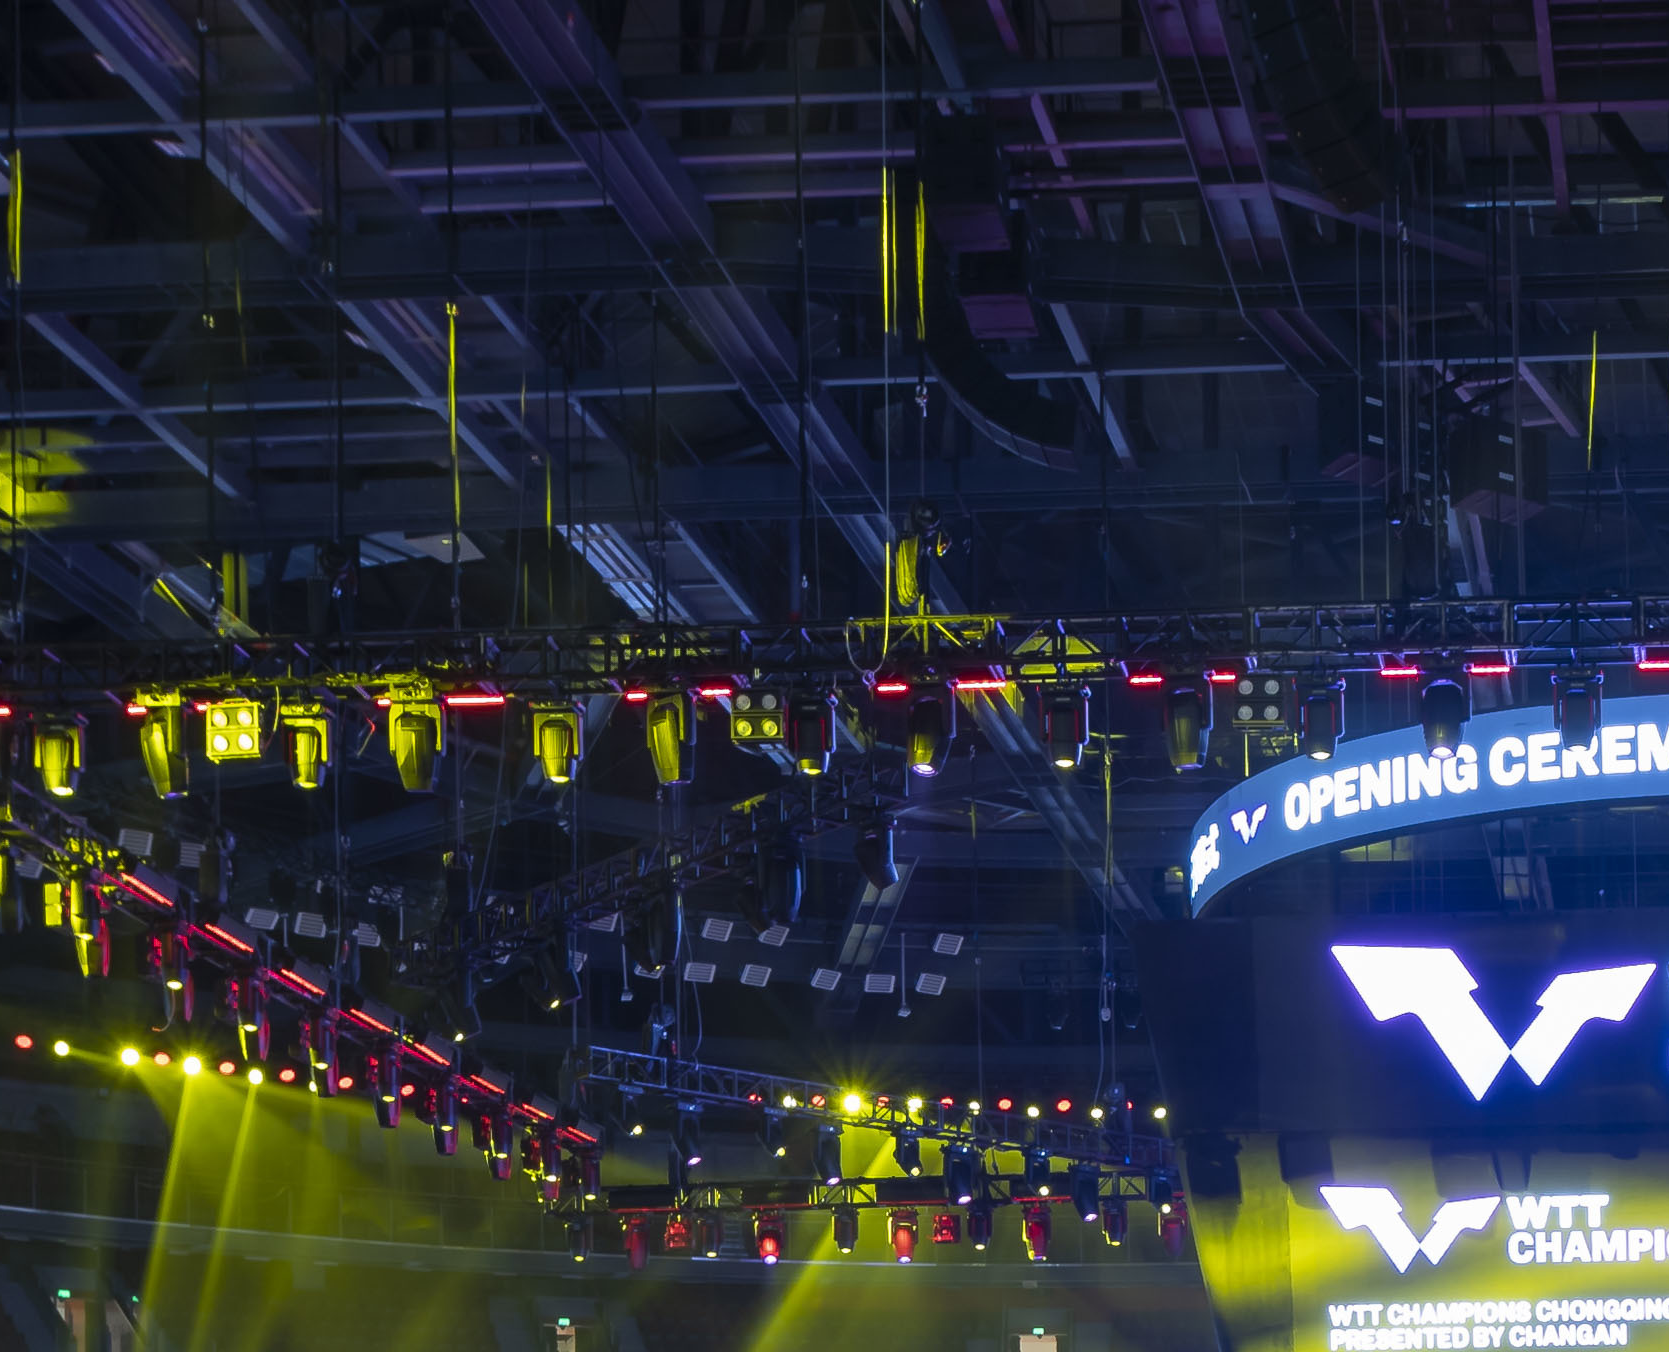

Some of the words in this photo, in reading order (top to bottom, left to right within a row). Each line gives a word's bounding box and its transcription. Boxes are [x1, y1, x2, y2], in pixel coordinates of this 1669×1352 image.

[1283, 743, 1479, 831] OPENING
[1505, 1194, 1610, 1230] WTT
[1329, 1303, 1384, 1326] WTT
[1386, 1301, 1532, 1326] CHAMPIONS
[1330, 1326, 1470, 1352] PRESENTED
[1473, 1326, 1505, 1349] BY
[1509, 1323, 1628, 1348] CHANGAN
